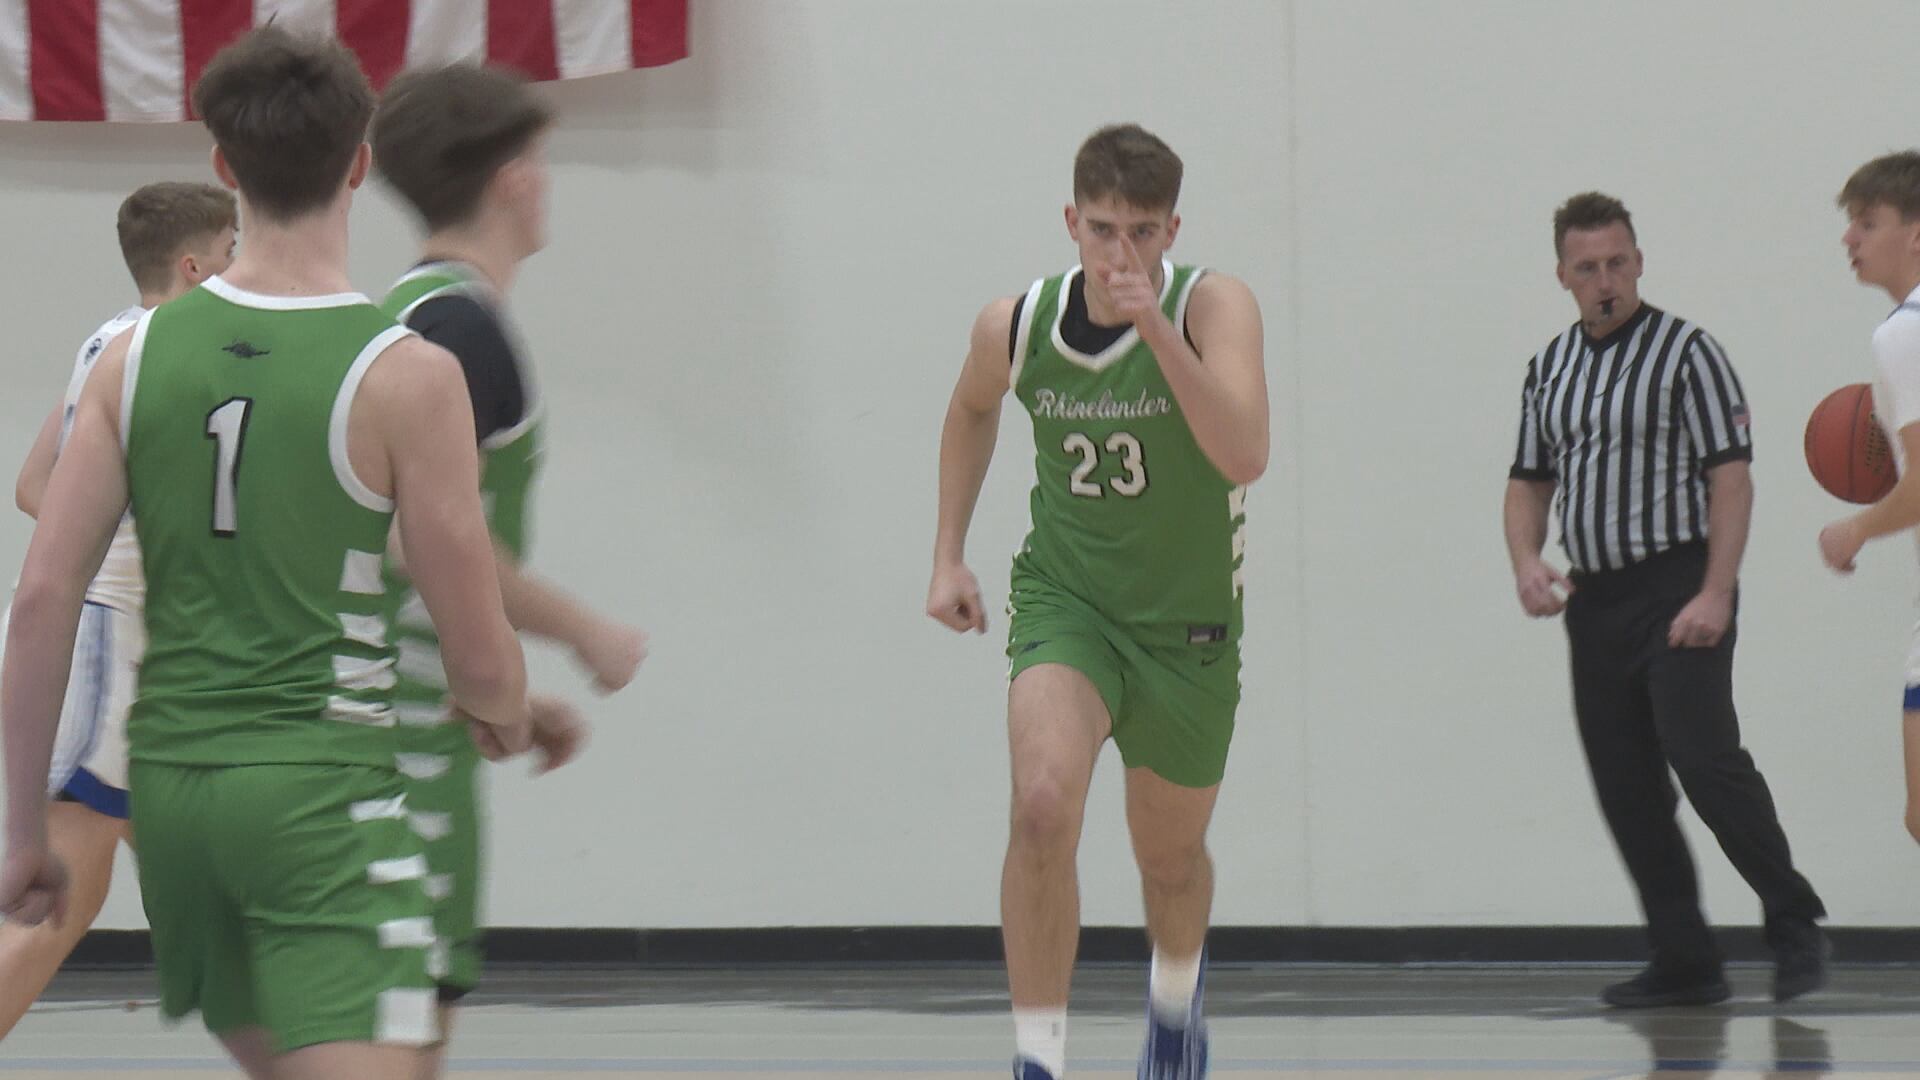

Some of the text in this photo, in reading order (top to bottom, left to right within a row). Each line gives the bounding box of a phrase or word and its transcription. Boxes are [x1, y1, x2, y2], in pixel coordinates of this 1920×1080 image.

[1033, 387, 1171, 419] Rhinelander
[206, 396, 253, 538] 1
[1062, 431, 1150, 498] 23
